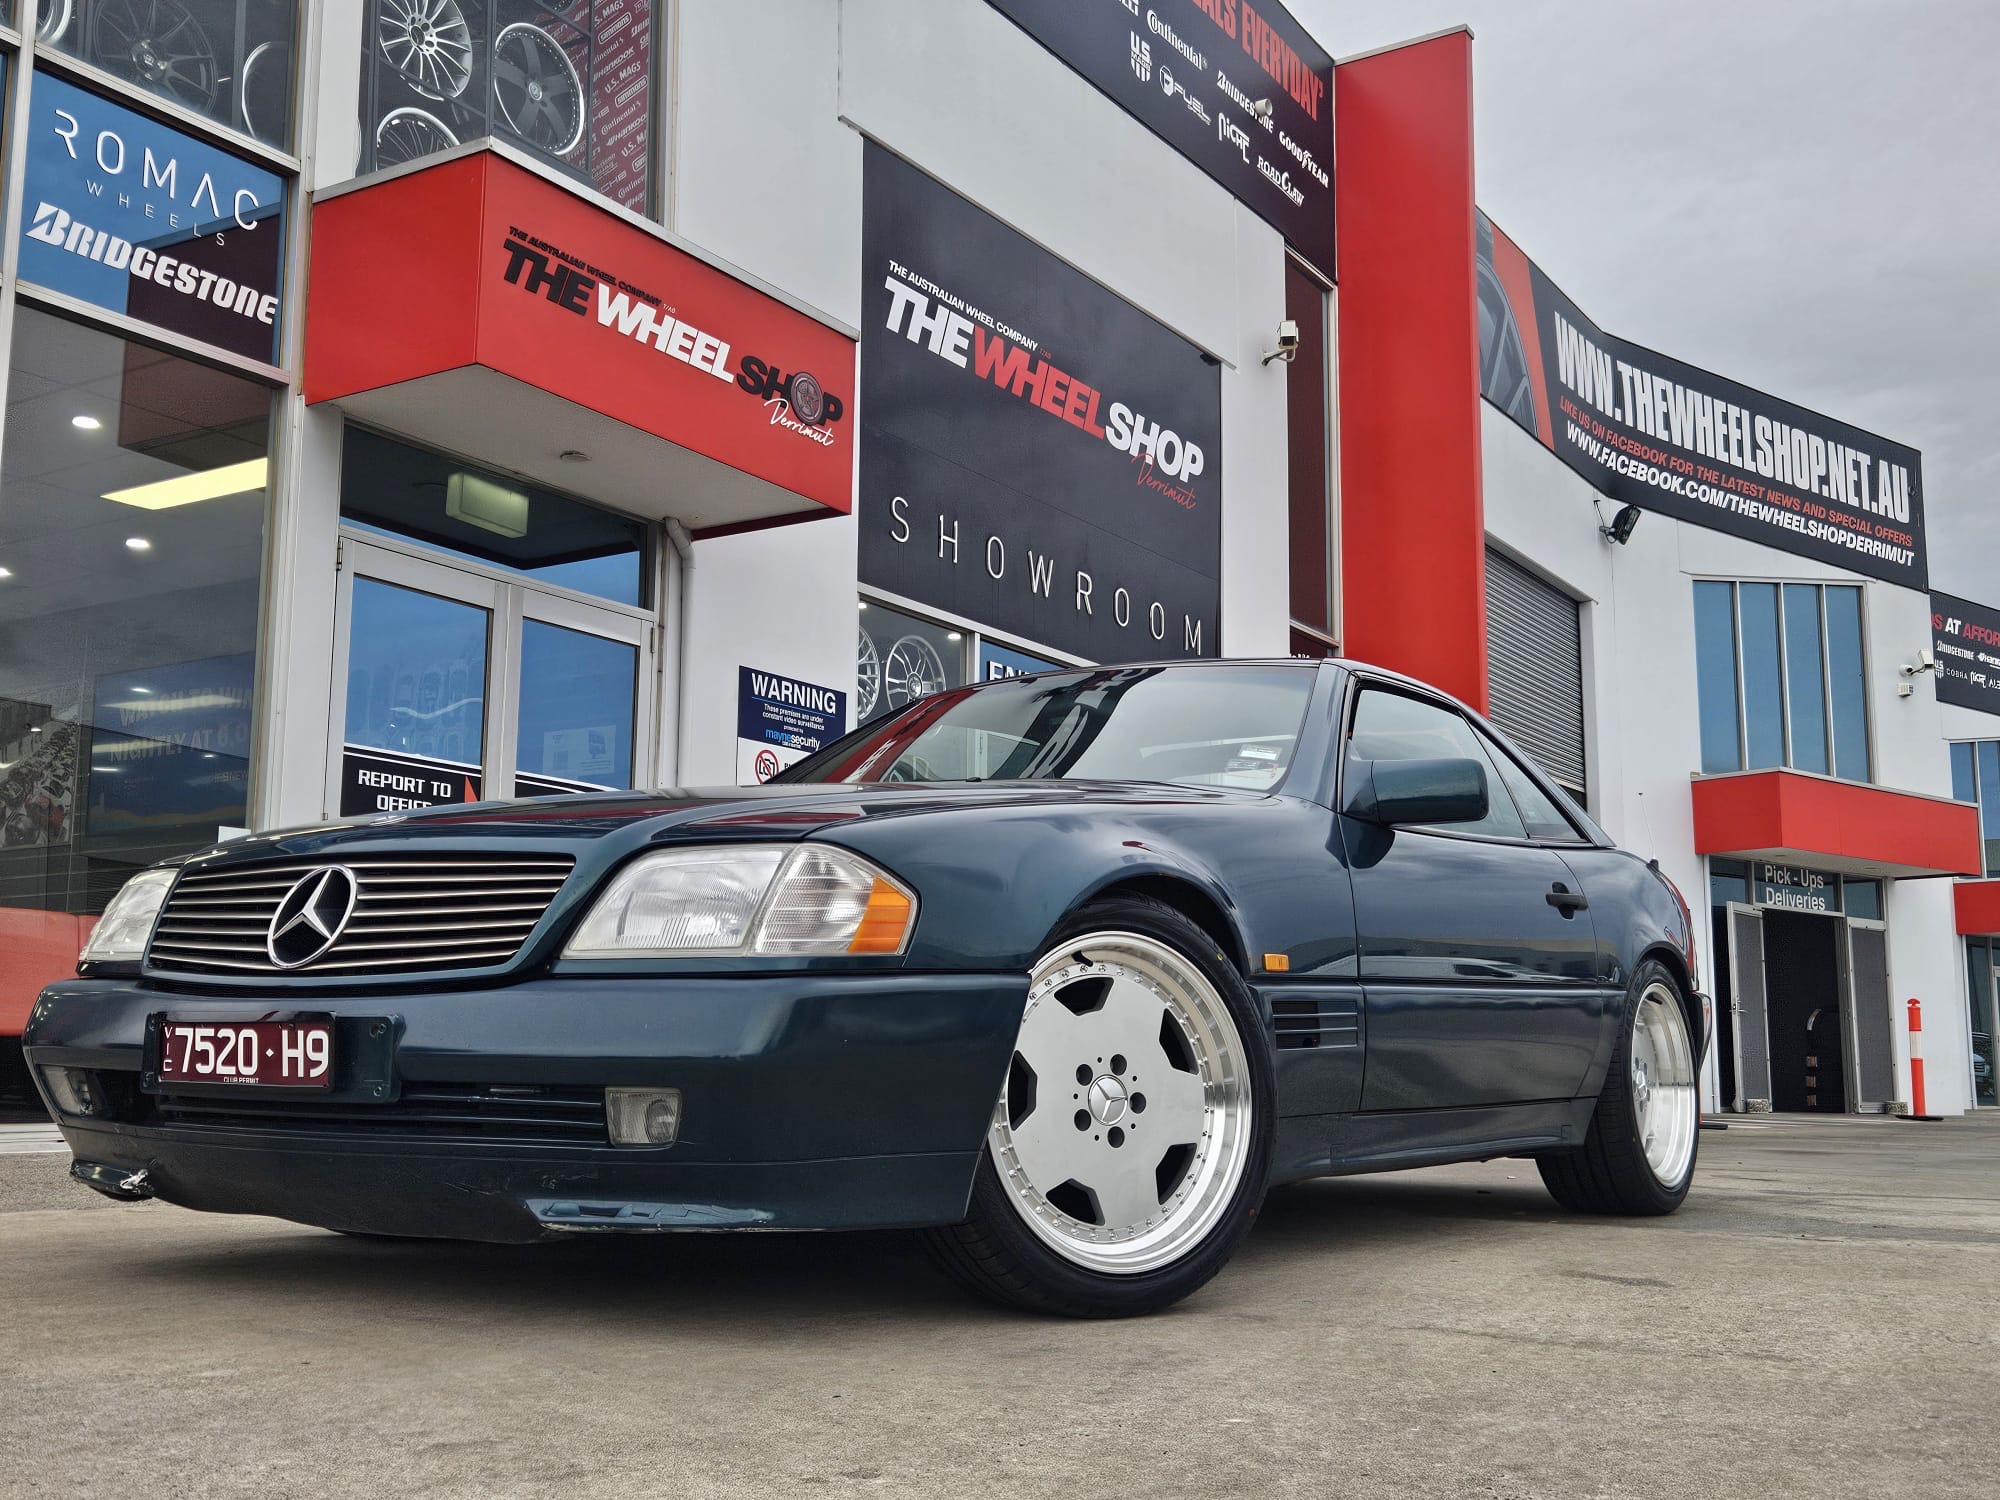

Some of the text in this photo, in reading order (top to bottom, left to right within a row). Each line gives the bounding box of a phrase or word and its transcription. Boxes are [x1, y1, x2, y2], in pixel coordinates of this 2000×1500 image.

[619, 60, 641, 81] MAGS
[1146, 9, 1202, 71] Continental
[54, 108, 260, 231] ROMAC
[1279, 131, 1328, 188] GOODYEAR
[86, 179, 226, 247] WHEELS
[25, 201, 280, 325] BRIDGESTONE
[509, 226, 529, 242] THE
[527, 236, 586, 271] AUSTRALIAN
[586, 264, 617, 287] WHEEL
[618, 281, 662, 306] COMPANY
[503, 238, 597, 317] THE
[597, 282, 734, 384] WHEEL
[888, 259, 908, 279] THE
[907, 272, 965, 312] AUSTRALIAN
[965, 303, 995, 329] WHEEL
[996, 321, 1039, 351] COMPANY
[884, 275, 1205, 483] THE WHEEL SHOP
[1554, 311, 1910, 524] WWW.THEWHEELSHOP.NET.AU
[1560, 395, 1913, 547] LIKE US ON FACEBOOK FOR THE LATEST NEWS AND SPECIAL OFFERS
[1567, 420, 1915, 567] WWW.FACEBOOK.COM/THEWHEELSHOPDERRIMUT
[891, 496, 1202, 657] SHOWROOM
[1944, 617, 1961, 635] AT
[751, 672, 837, 715] WARNING
[763, 703, 779, 714] These
[358, 769, 452, 798] REPORT TO
[1766, 887, 1826, 911] Deliveries
